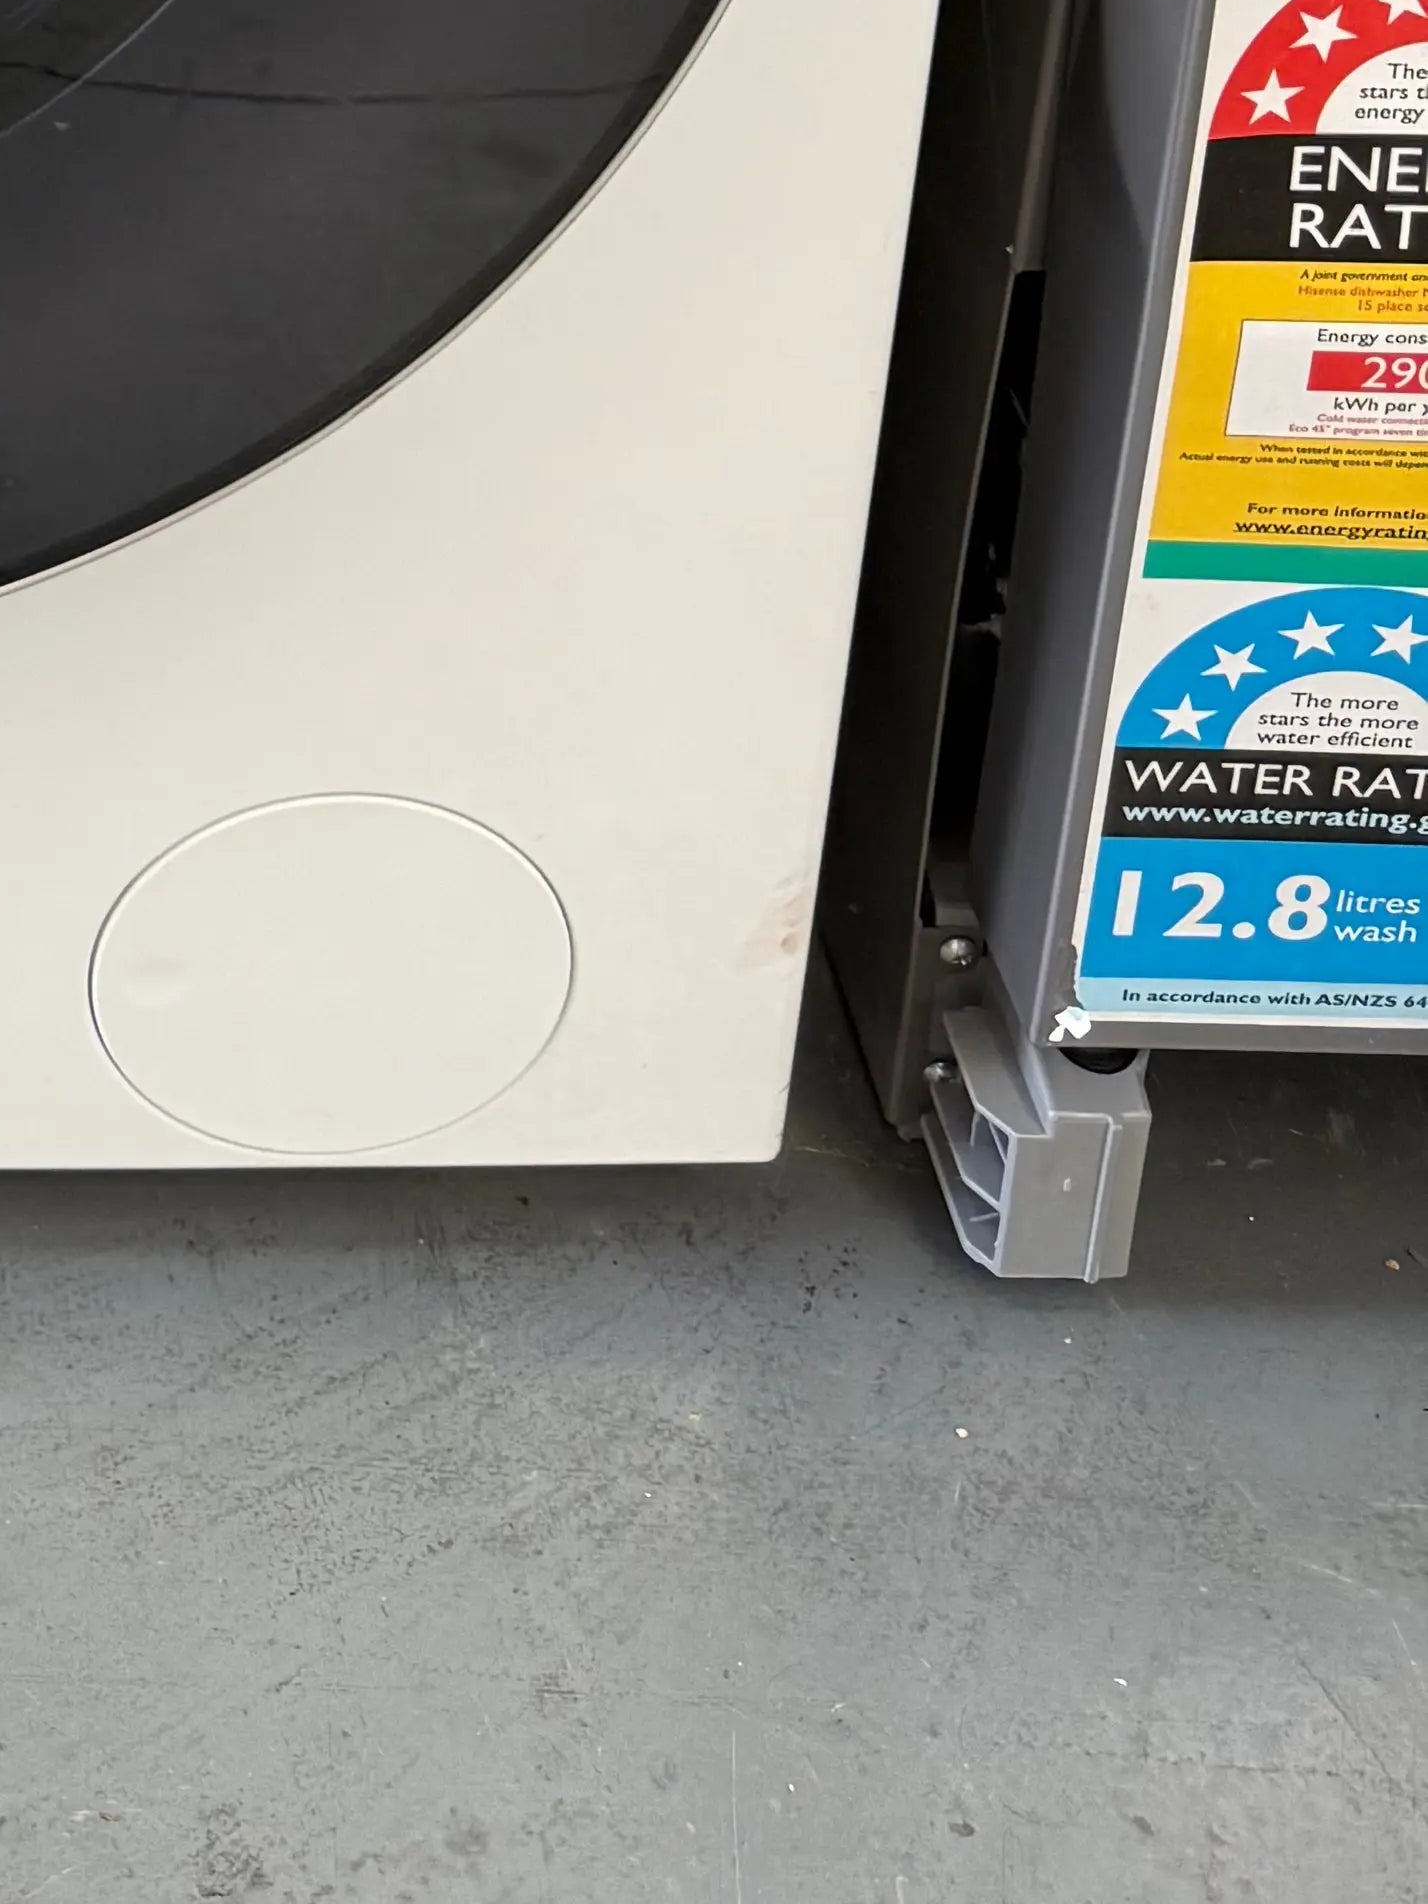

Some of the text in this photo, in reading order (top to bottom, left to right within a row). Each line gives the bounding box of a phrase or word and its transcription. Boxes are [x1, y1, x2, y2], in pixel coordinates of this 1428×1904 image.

[1360, 88, 1408, 100] stars
[1355, 107, 1425, 124] energy
[1289, 145, 1428, 192] ENE
[1300, 269, 1309, 280] A
[1312, 270, 1337, 283] joint
[1341, 272, 1408, 283] government
[1298, 286, 1345, 296] Hisense
[1350, 286, 1418, 297] dishwasher
[1358, 301, 1371, 311] 15
[1377, 301, 1412, 313] place
[1317, 329, 1378, 347] Energy
[1334, 397, 1378, 412] kWh
[1385, 402, 1416, 415] per
[1248, 503, 1277, 515] For
[1282, 506, 1328, 516] more
[1291, 692, 1398, 711] The more
[1258, 713, 1419, 731] stars the more
[1257, 732, 1413, 749] water efficient
[1124, 760, 1313, 797] WATER
[1112, 870, 1331, 941] 12.8
[1336, 890, 1420, 914] litres
[1334, 921, 1417, 943] wash
[1122, 989, 1140, 1002] In
[1147, 992, 1261, 1005] accordance
[1268, 993, 1311, 1006] with
[1314, 993, 1397, 1008] AS/NZS
